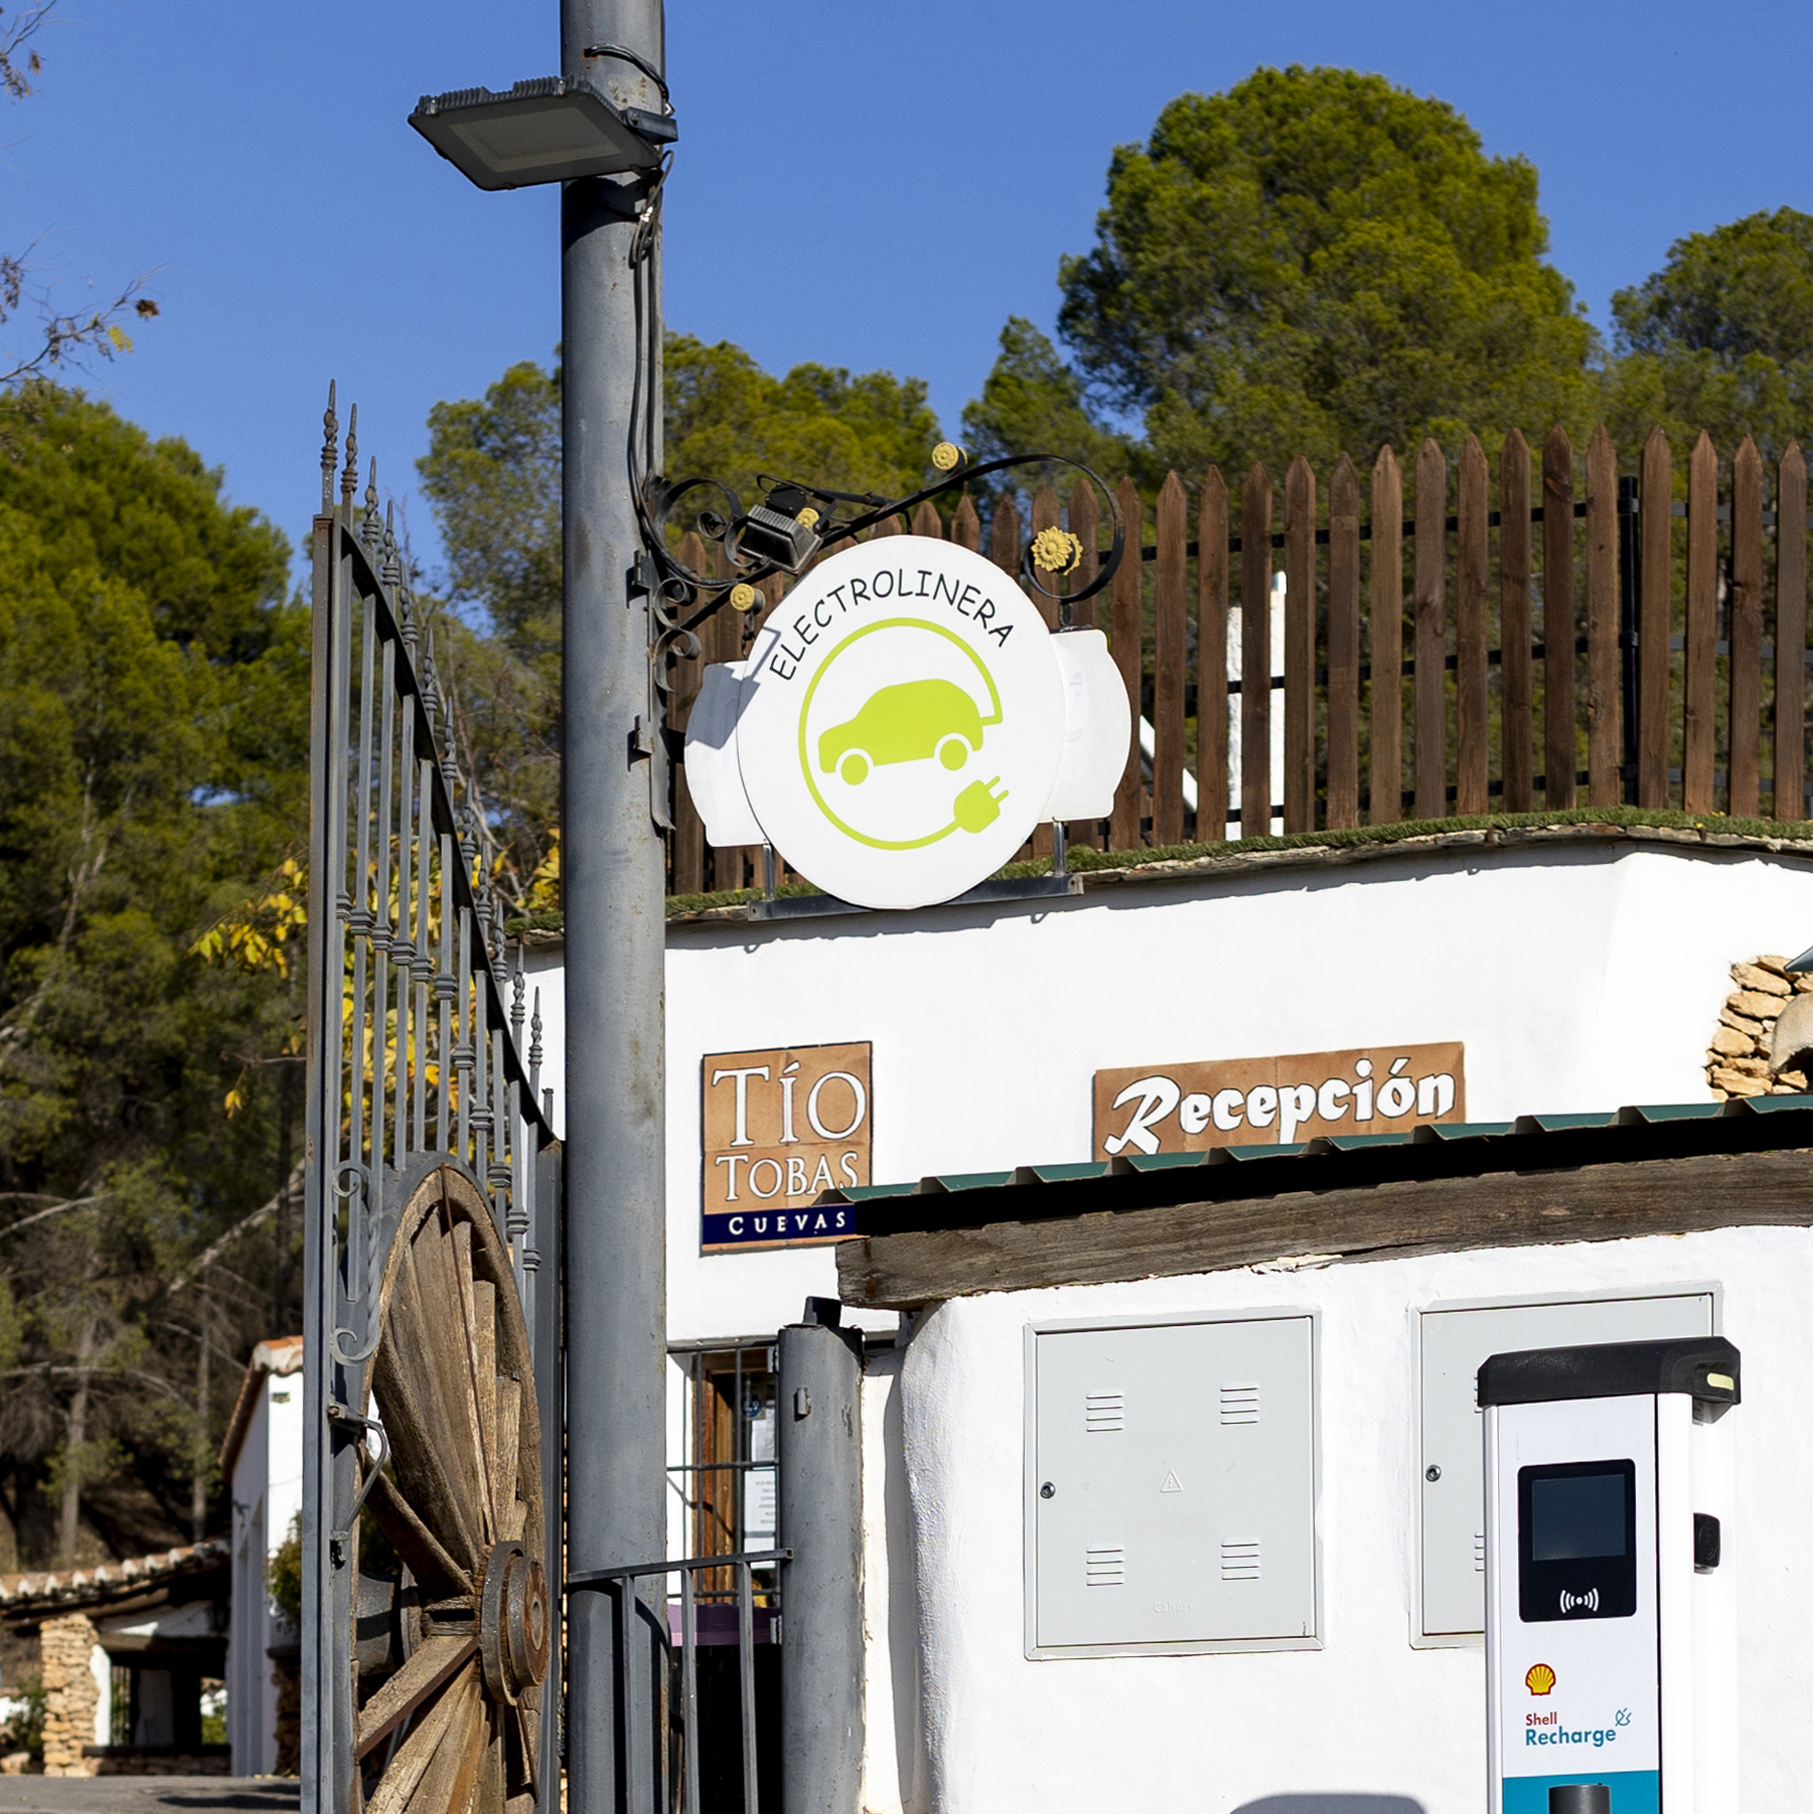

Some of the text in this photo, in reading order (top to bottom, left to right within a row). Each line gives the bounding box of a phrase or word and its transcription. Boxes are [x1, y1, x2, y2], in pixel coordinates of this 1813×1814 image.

[769, 568, 1014, 681] ELECTROLINERA
[711, 1060, 867, 1147] TÍO
[1102, 1057, 1456, 1155] Recepción
[715, 1151, 858, 1201] TOBAS
[728, 1211, 846, 1236] CUEVAS
[1525, 1711, 1558, 1726] Shell
[1525, 1725, 1617, 1748] Recharge
